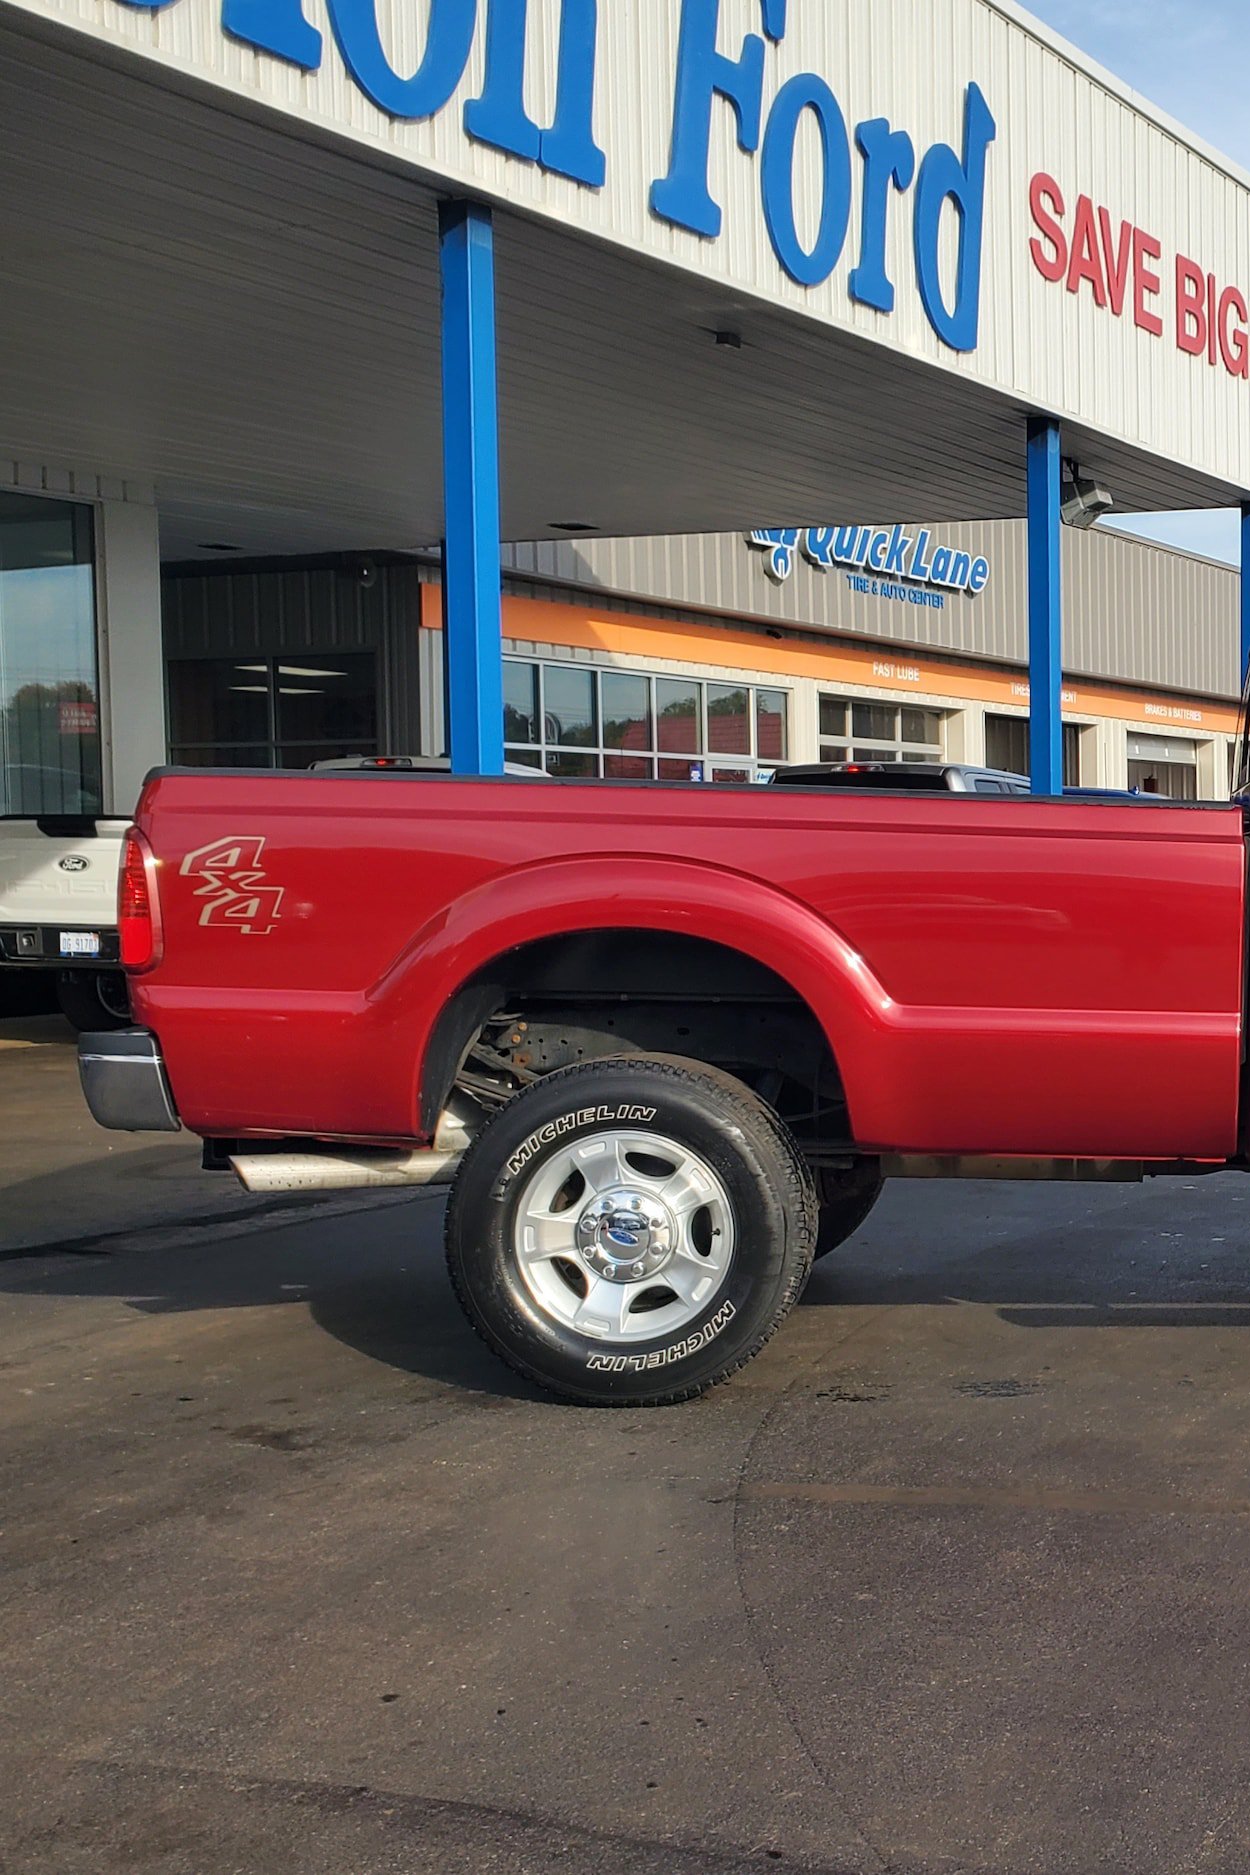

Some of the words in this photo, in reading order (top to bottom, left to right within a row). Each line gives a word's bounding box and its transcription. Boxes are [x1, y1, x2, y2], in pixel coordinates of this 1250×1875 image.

[651, 0, 996, 352] Ford
[1028, 172, 1164, 337] SAVE
[806, 524, 914, 576] Quick
[908, 528, 990, 594] Lane
[847, 574, 869, 593] TIRE
[871, 580, 879, 595] &
[880, 582, 906, 601] AUTO
[908, 588, 944, 609] CENTER
[873, 661, 895, 678] FAST
[897, 664, 920, 681] LUBE
[1010, 682, 1030, 696] TIRES
[1144, 703, 1168, 717] BRAKES
[1173, 708, 1202, 722] BATTERIES
[506, 1104, 657, 1175] MICHELIN
[586, 1300, 737, 1372] MICHELIN
